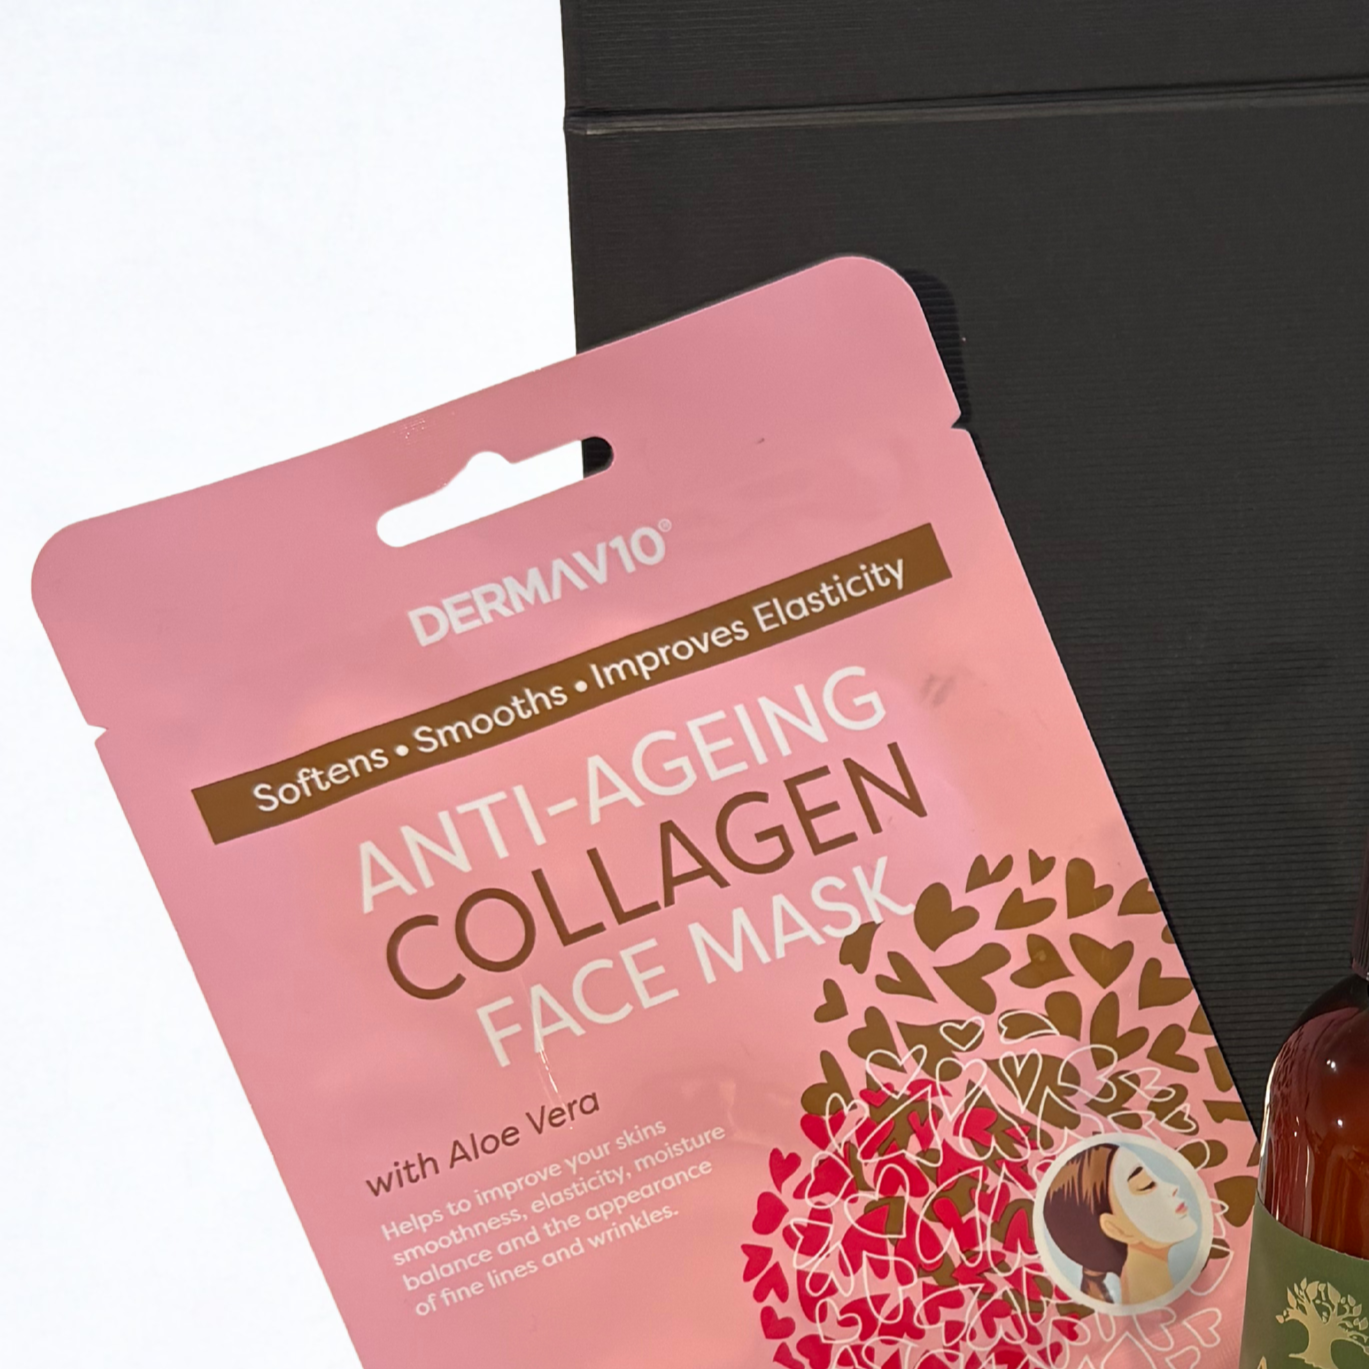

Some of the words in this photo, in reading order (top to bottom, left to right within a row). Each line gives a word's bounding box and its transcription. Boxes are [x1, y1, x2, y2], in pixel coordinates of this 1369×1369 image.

[252, 746, 389, 813] Softens
[414, 682, 568, 754] Smooths
[590, 619, 750, 689] Improves
[751, 557, 905, 633] Elasticity
[358, 665, 886, 914] ANTI-AGEING
[386, 741, 928, 1000] COLLAGEN
[476, 938, 679, 1067] FACE
[687, 855, 916, 984] MASK
[365, 1152, 440, 1197] with
[449, 1125, 521, 1169] Aloe
[525, 1092, 600, 1136] Vera
[380, 1207, 444, 1242] Helps
[446, 1198, 472, 1217] to
[474, 1161, 563, 1208] improve
[565, 1141, 611, 1175] your
[615, 1120, 668, 1151] skins
[393, 1211, 529, 1267] smoothness,
[531, 1164, 633, 1214] elasticity,
[633, 1124, 726, 1174] moisture
[402, 1246, 494, 1292] balance
[496, 1226, 541, 1257] and
[541, 1215, 582, 1239] the
[585, 1160, 714, 1224] appearance
[415, 1294, 437, 1317] of
[440, 1278, 485, 1306] fine
[487, 1260, 539, 1289] lines
[542, 1238, 585, 1270] and
[587, 1206, 680, 1247] wrinkles.
